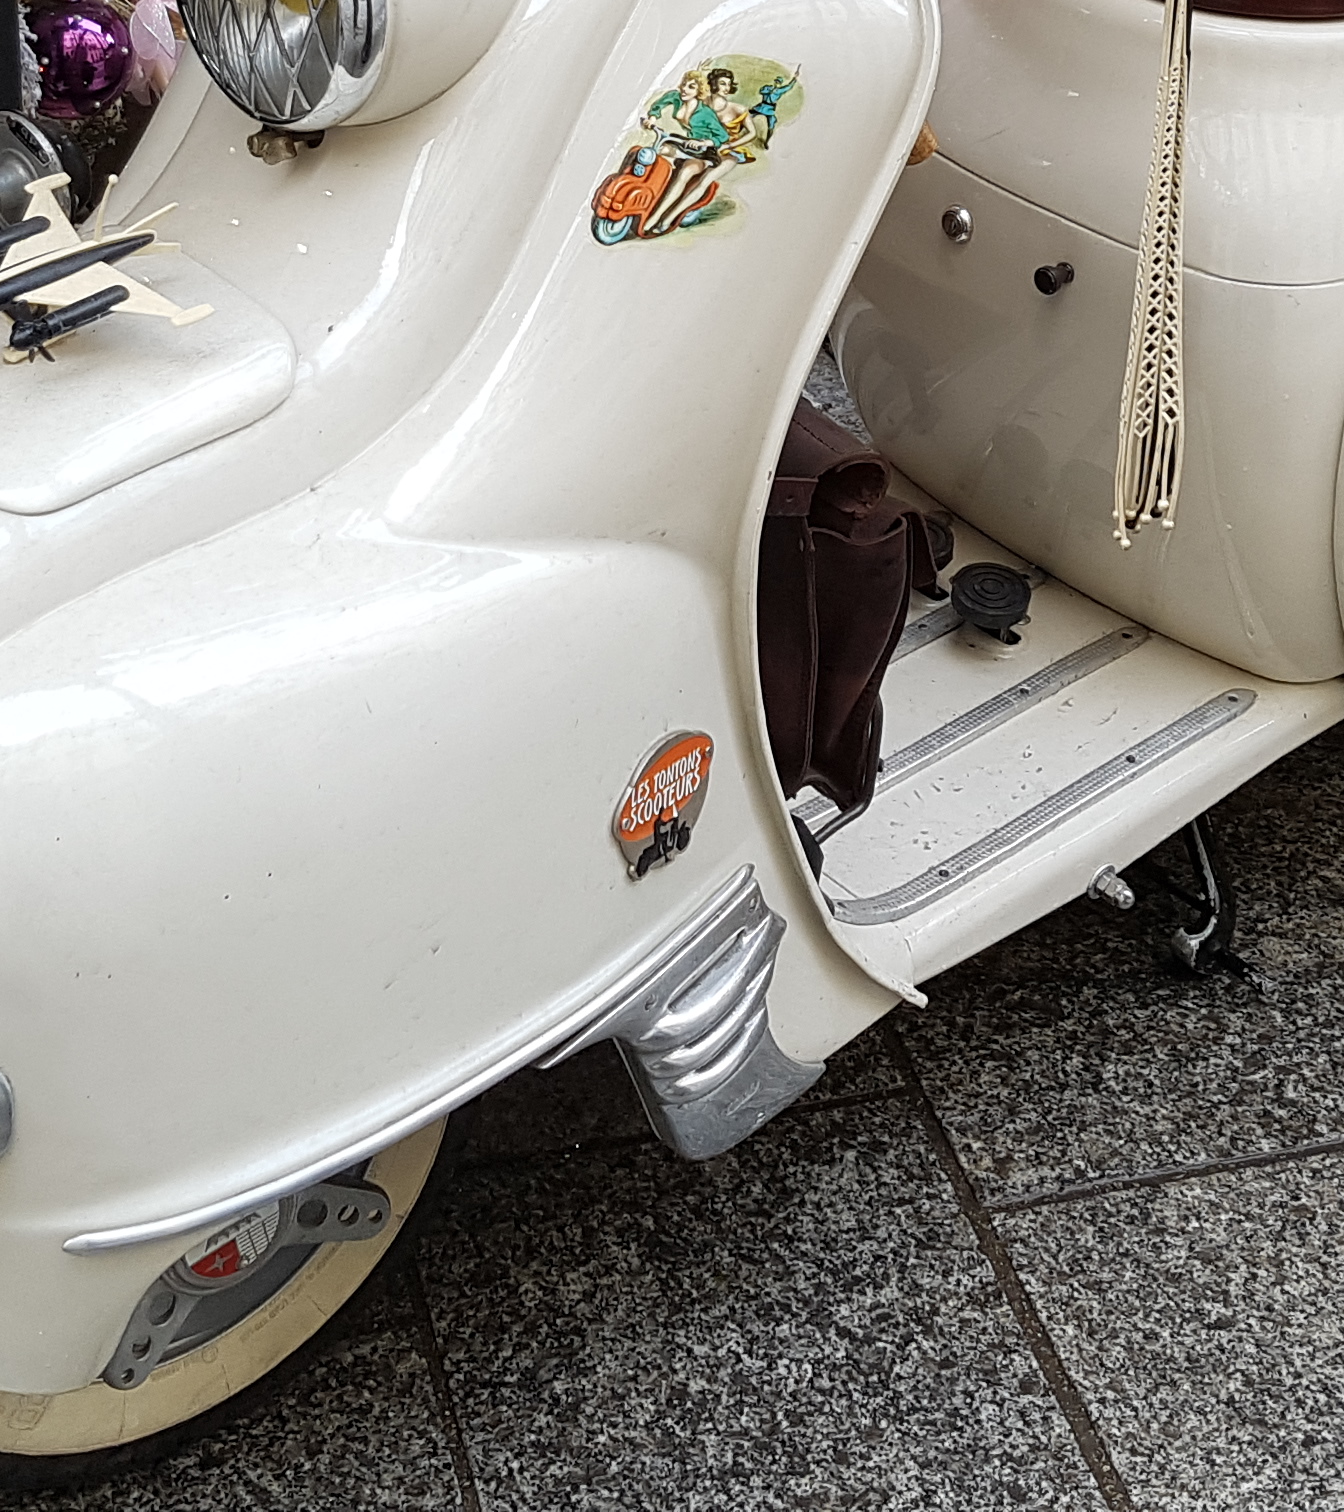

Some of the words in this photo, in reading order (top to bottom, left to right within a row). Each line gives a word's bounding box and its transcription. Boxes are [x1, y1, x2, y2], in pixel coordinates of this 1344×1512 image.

[630, 778, 650, 807] LES
[654, 747, 702, 794] TONTONS
[630, 767, 701, 832] SCOOTEURS
